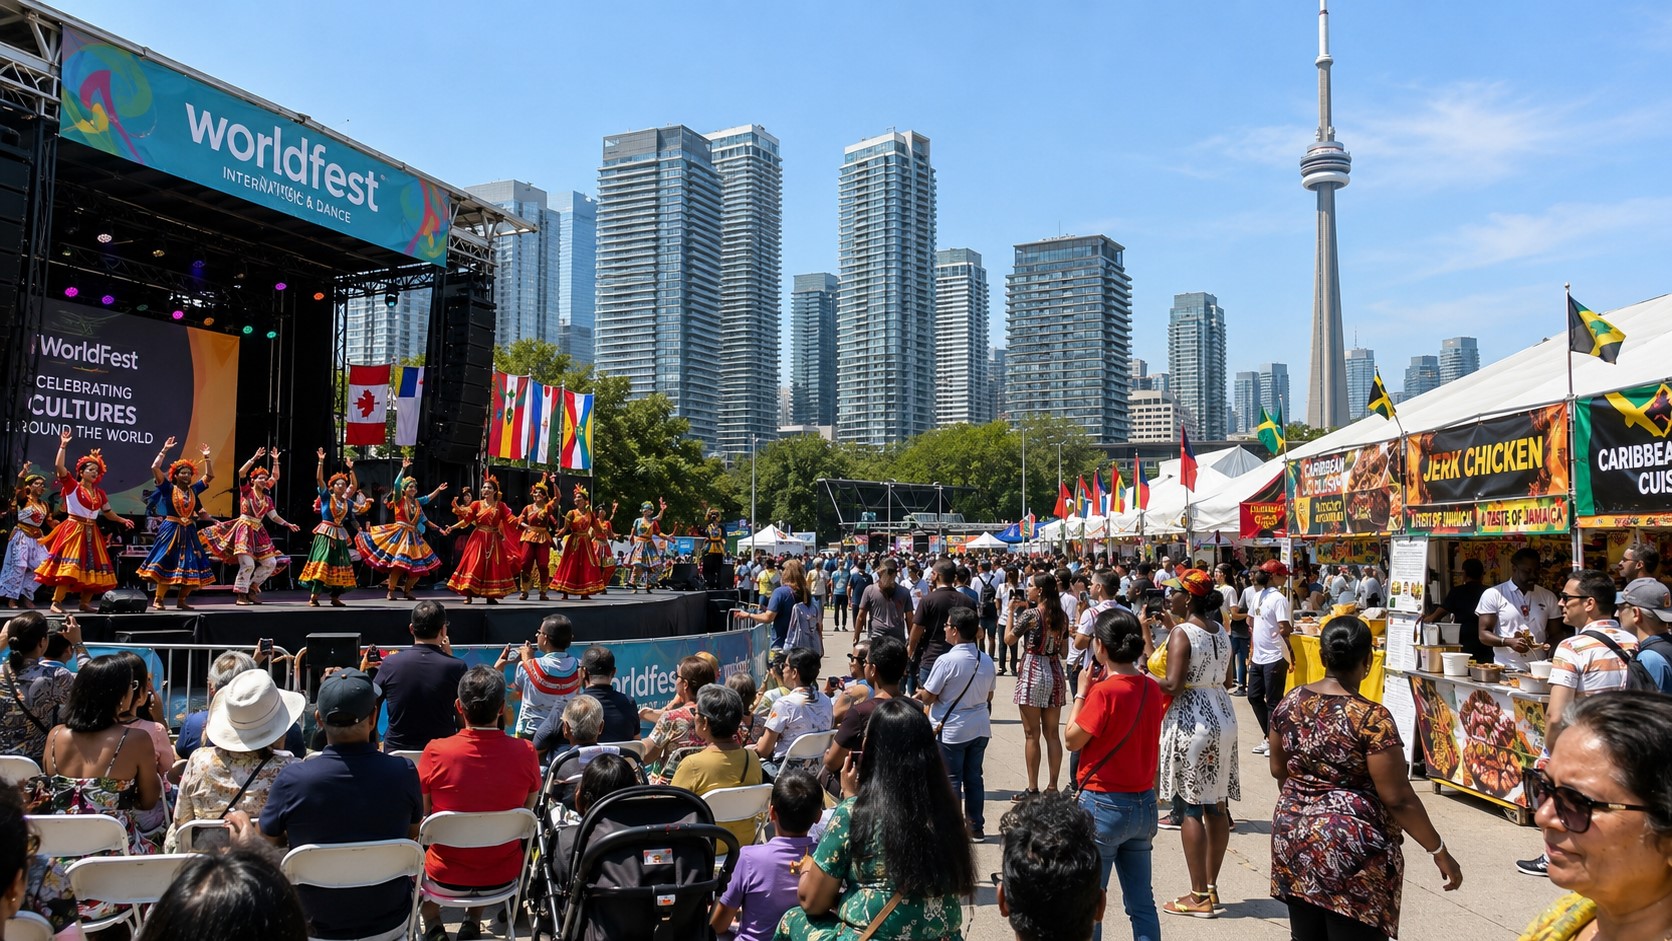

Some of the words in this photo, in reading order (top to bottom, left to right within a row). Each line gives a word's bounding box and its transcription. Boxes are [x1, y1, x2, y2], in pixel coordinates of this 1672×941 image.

[185, 102, 379, 212] worldfest
[316, 199, 352, 223] DANCE
[40, 334, 139, 370] WorldFest
[36, 374, 133, 400] CELEBRATING
[29, 394, 137, 425] CULTURES
[76, 425, 103, 440] THE
[106, 428, 154, 445] WORLD
[1423, 449, 1462, 482] JERK
[1464, 435, 1543, 478] CHICKEN
[1511, 508, 1522, 526] OF
[610, 664, 681, 698] orldfes
